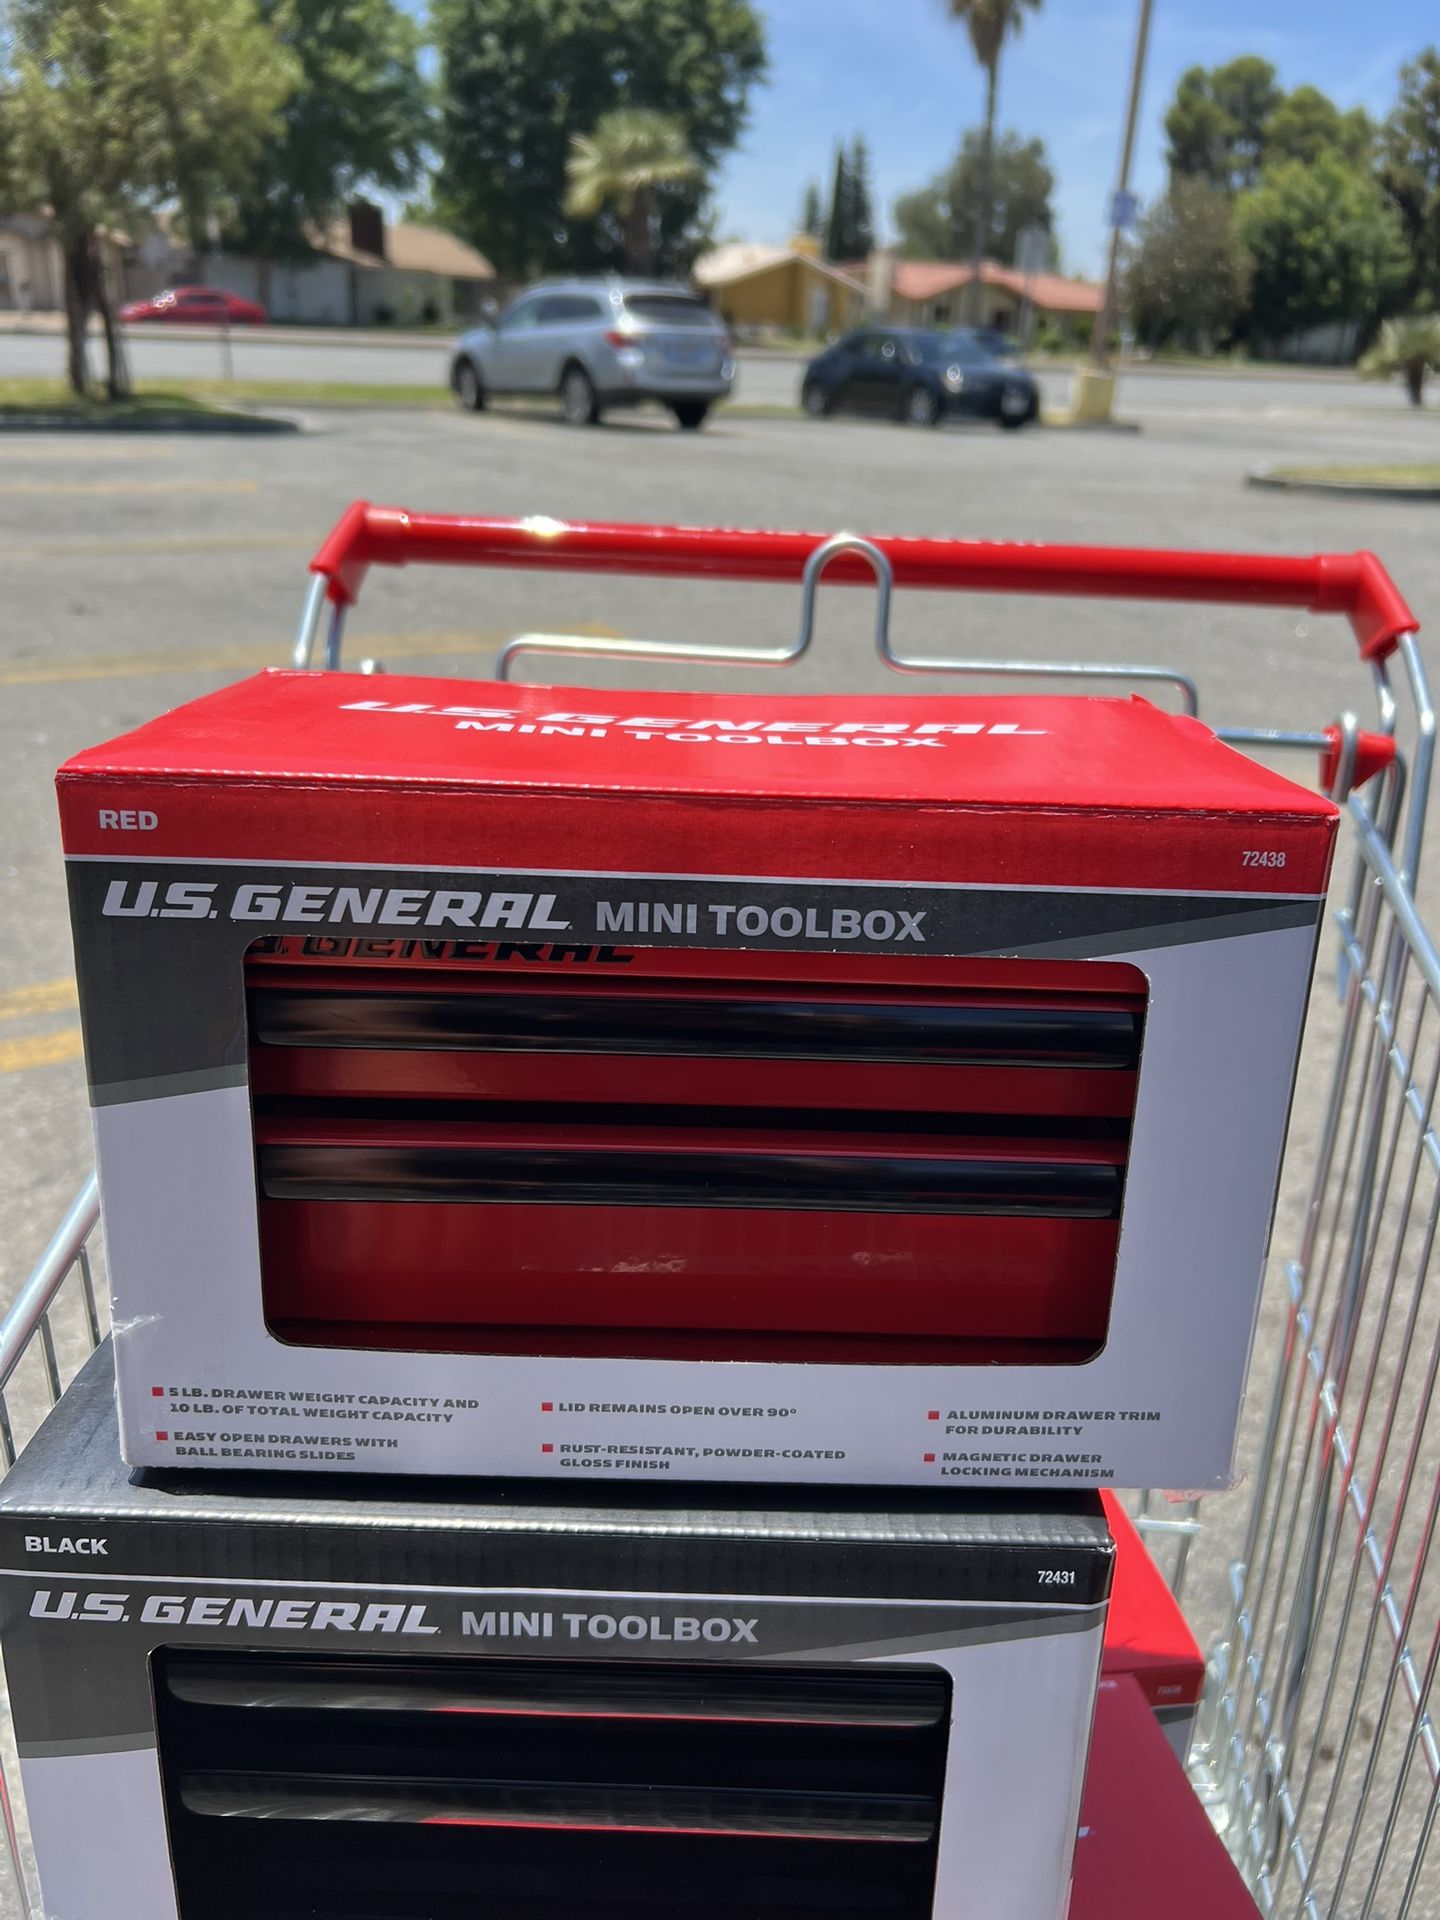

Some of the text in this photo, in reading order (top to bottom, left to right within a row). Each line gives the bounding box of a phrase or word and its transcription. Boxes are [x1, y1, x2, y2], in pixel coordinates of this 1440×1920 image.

[339, 701, 1049, 735] U.S. GENERAL
[455, 720, 948, 748] MINI TOOLBOX
[99, 810, 158, 830] RED
[1242, 850, 1287, 868] 72438
[102, 881, 570, 930] U.S. GENERAL
[597, 902, 926, 941] MINI TOOLBOX
[169, 1387, 479, 1409] 5 LB. DRAWER WEIGHT CAPACITY AND
[170, 1402, 454, 1423] 10 LB. OF TOTAL WEIGHT CAPACITY
[558, 1402, 586, 1412] LID
[588, 1403, 667, 1414] REMAINS
[669, 1405, 715, 1416] OPEN
[718, 1406, 764, 1417] OVER
[946, 1410, 1161, 1421] ALUMINUM DRAWER TRIM
[173, 1431, 398, 1448] EASY OPEN DRAWERS WITH
[945, 1425, 1084, 1436] FOR DURABILITY
[175, 1446, 356, 1461] BALL BEARING SLIDES
[559, 1444, 846, 1460] RUST-RESISTANT, POWDER-COATED
[942, 1452, 1103, 1464] MAGNETIC DRAWER
[559, 1458, 670, 1470] GLOSS FINISH
[940, 1466, 1114, 1478] LOCKING MECHANISM
[25, 1536, 108, 1554] BLACK
[1037, 1570, 1075, 1585] 72431
[30, 1591, 441, 1633] U.S. GENERAL
[463, 1612, 758, 1642] MINI TOOLBOX
